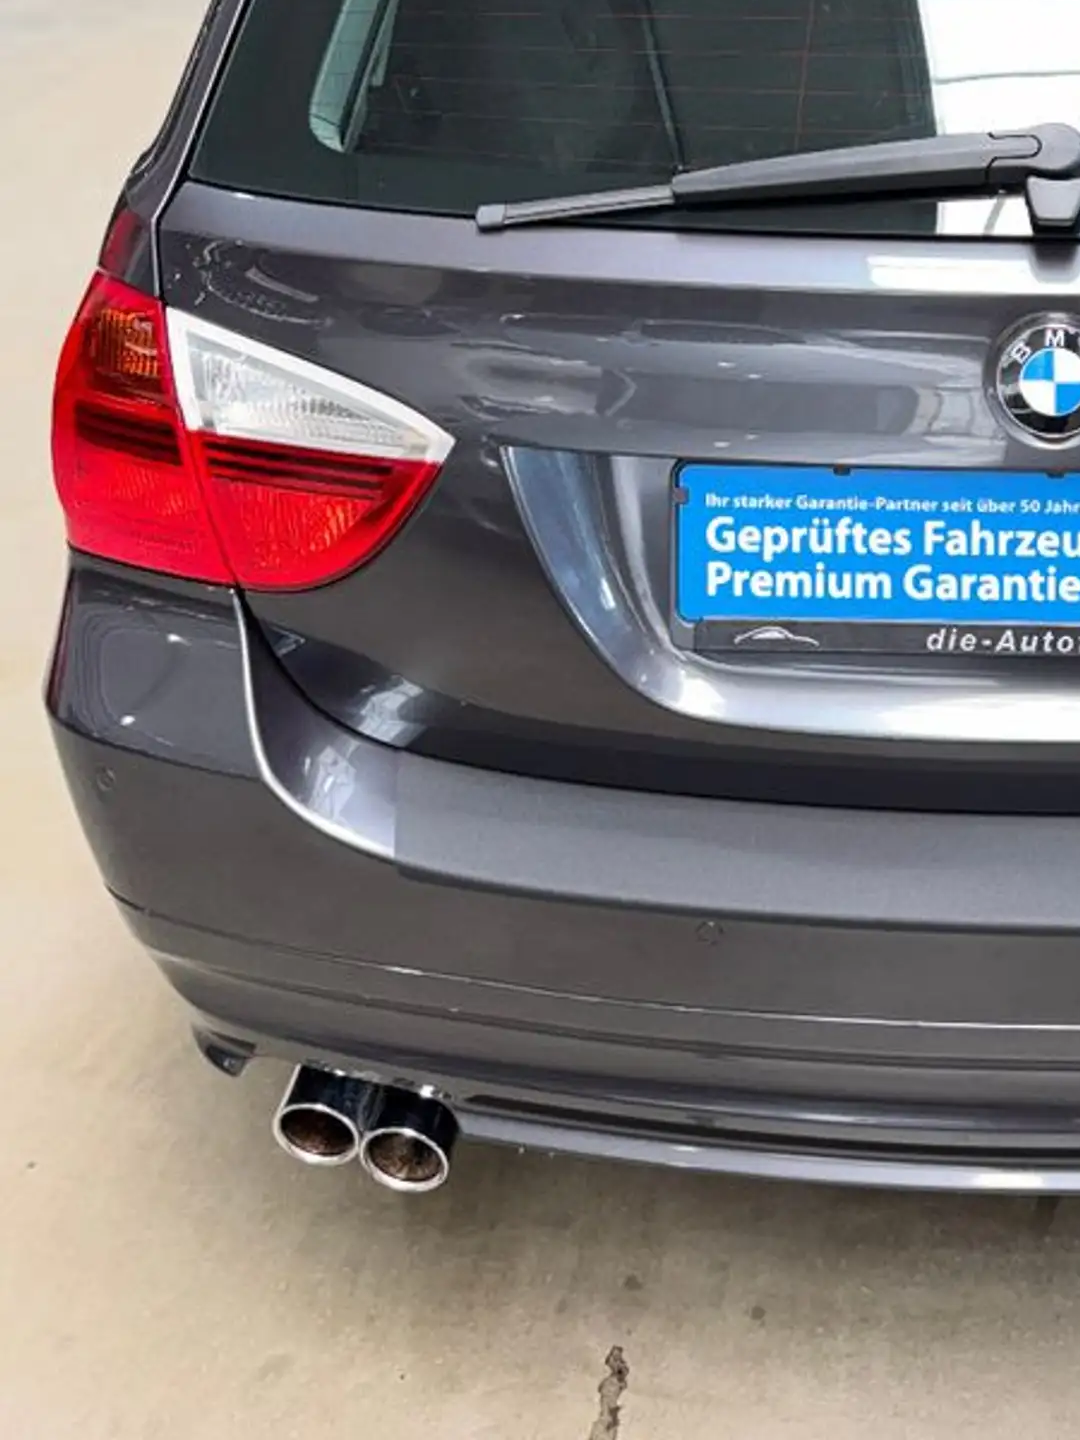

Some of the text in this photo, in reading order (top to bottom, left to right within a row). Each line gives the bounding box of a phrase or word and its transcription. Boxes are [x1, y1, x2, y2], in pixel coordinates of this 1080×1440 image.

[705, 492, 730, 509] Ihr
[733, 493, 793, 510] starker
[795, 495, 938, 512] Garantie-Partner
[942, 498, 973, 513] seit
[976, 497, 1015, 514] über
[1020, 499, 1041, 514] 50
[705, 515, 912, 562] Geprüftes
[705, 561, 892, 600] Premium
